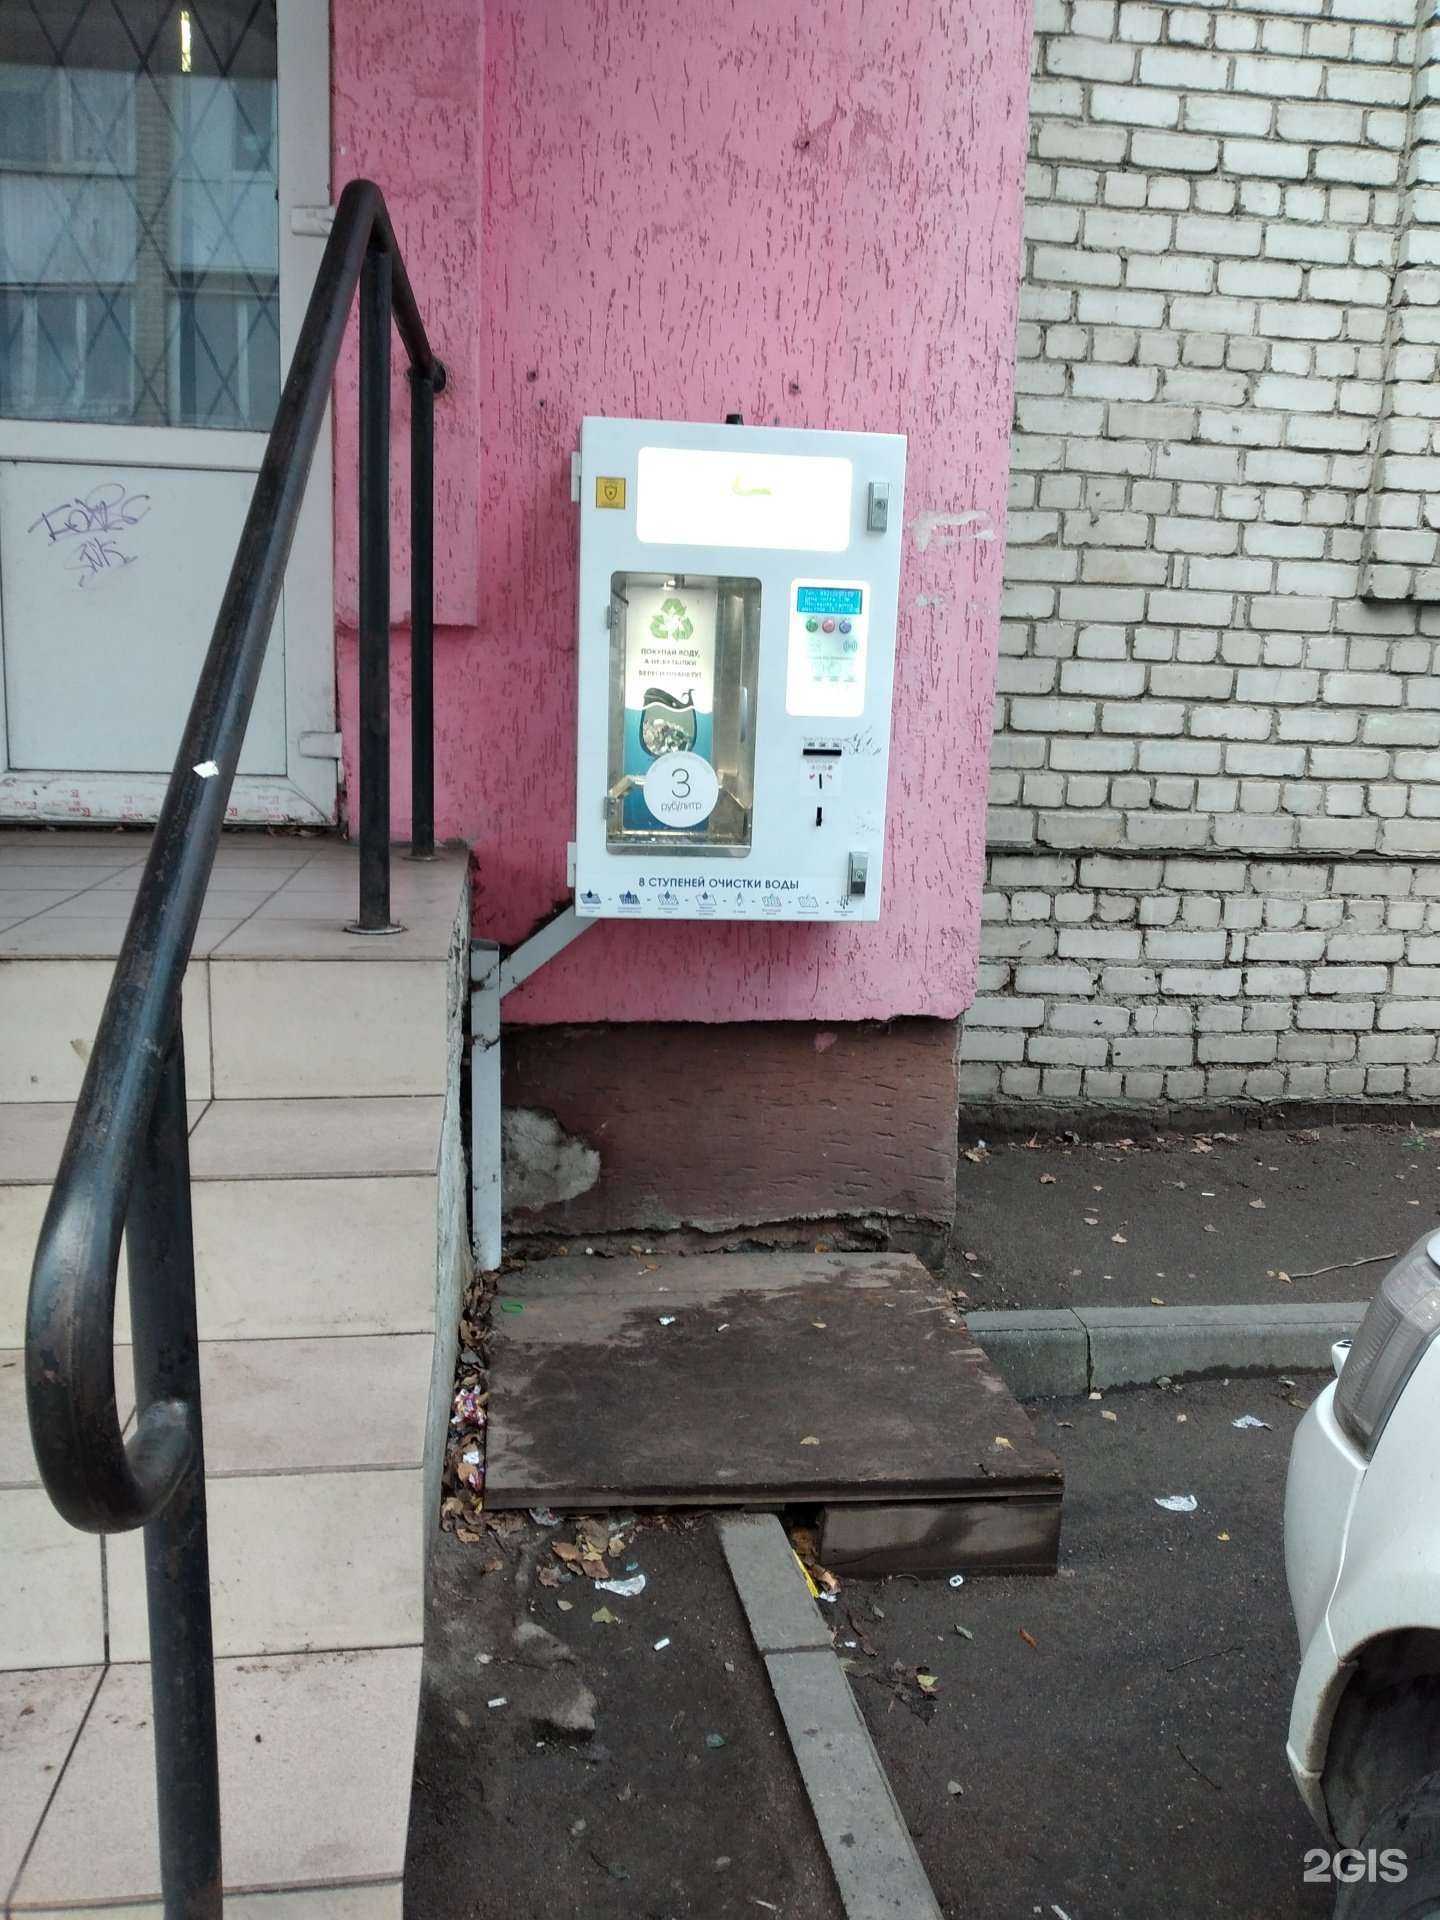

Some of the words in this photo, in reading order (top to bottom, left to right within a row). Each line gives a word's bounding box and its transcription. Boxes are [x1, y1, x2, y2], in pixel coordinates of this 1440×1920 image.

[671, 768, 691, 798] 3
[661, 800, 702, 813] руб/литр
[638, 877, 646, 887] 8
[648, 876, 705, 888] СТУПЕНЕЙ
[709, 878, 762, 889] ОЧИСТКИ
[765, 879, 799, 890] ВОДЫ
